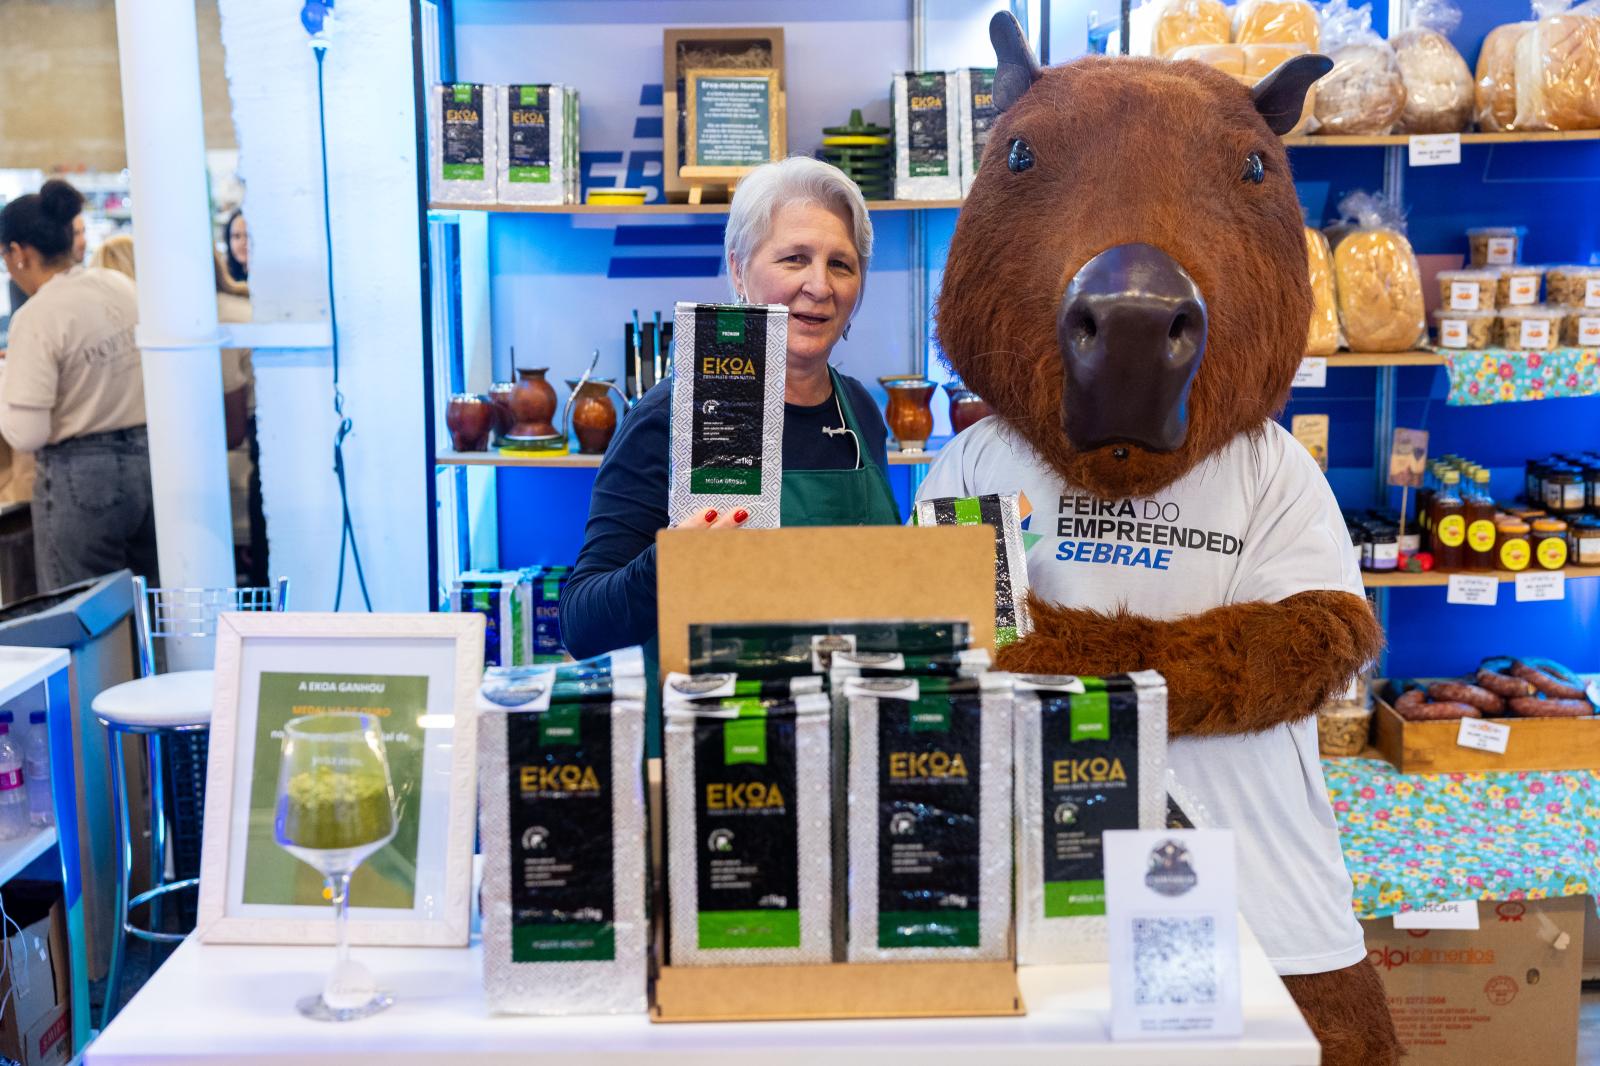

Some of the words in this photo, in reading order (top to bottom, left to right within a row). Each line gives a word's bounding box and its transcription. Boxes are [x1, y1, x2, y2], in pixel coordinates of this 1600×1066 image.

[446, 109, 479, 121] EKOA
[911, 95, 942, 108] EKOA
[512, 111, 545, 124] EKOA
[702, 357, 756, 375] EKOA
[1058, 495, 1137, 519] FEIRA
[1143, 500, 1180, 522] DO
[1055, 540, 1173, 571] SEBRAE
[298, 681, 307, 691] A
[309, 682, 337, 692] EKOA
[338, 682, 385, 693] GANHOU
[519, 764, 601, 791] EKOA
[889, 751, 969, 778] EKOA
[1053, 756, 1128, 784] EKOA
[705, 781, 785, 809] EKOA
